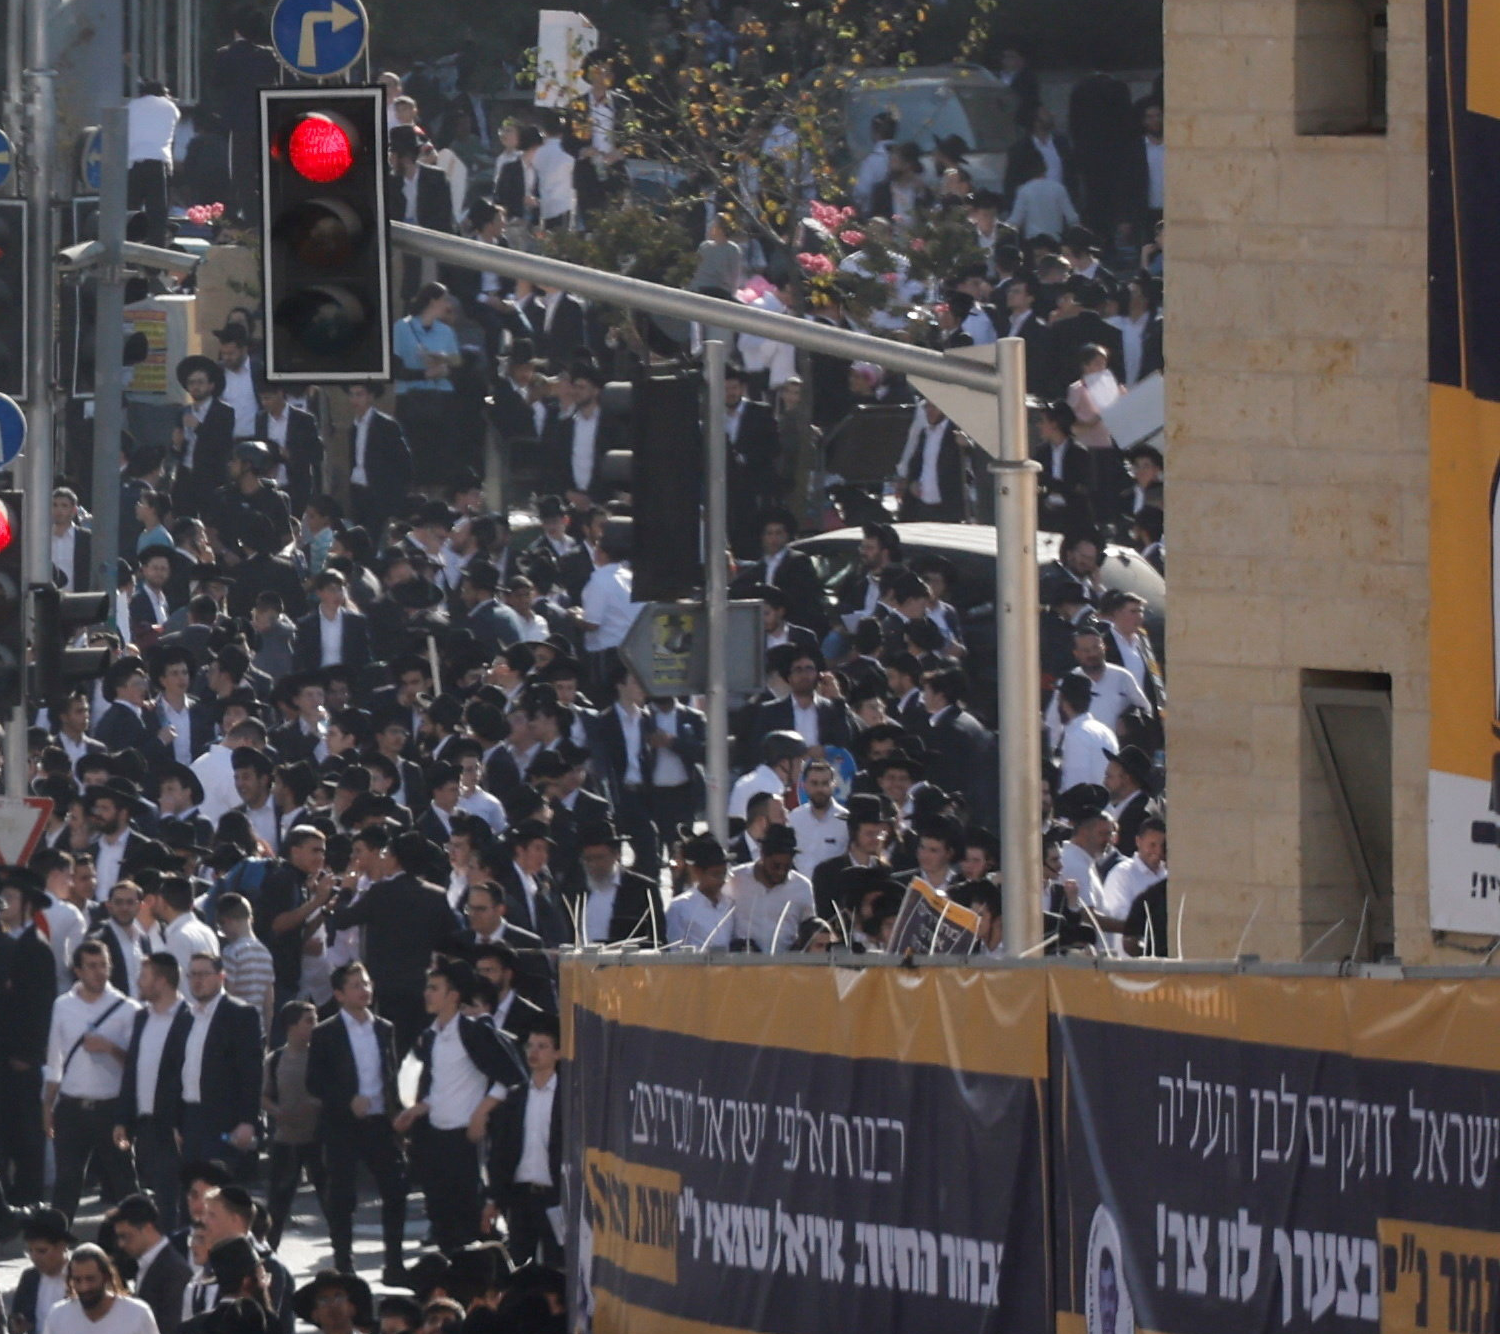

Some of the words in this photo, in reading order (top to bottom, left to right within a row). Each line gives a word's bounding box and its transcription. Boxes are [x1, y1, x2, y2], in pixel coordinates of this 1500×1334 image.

[698, 1079, 766, 1165] ישראל
[776, 1093, 826, 1177] אלפי
[1158, 1061, 1238, 1160] העליה
[1250, 1073, 1298, 1181] לבן
[1409, 1089, 1500, 1189] ישראל
[1156, 1203, 1209, 1296] צר!
[1218, 1209, 1263, 1303] לנו
[1273, 1228, 1379, 1327] בצערך
